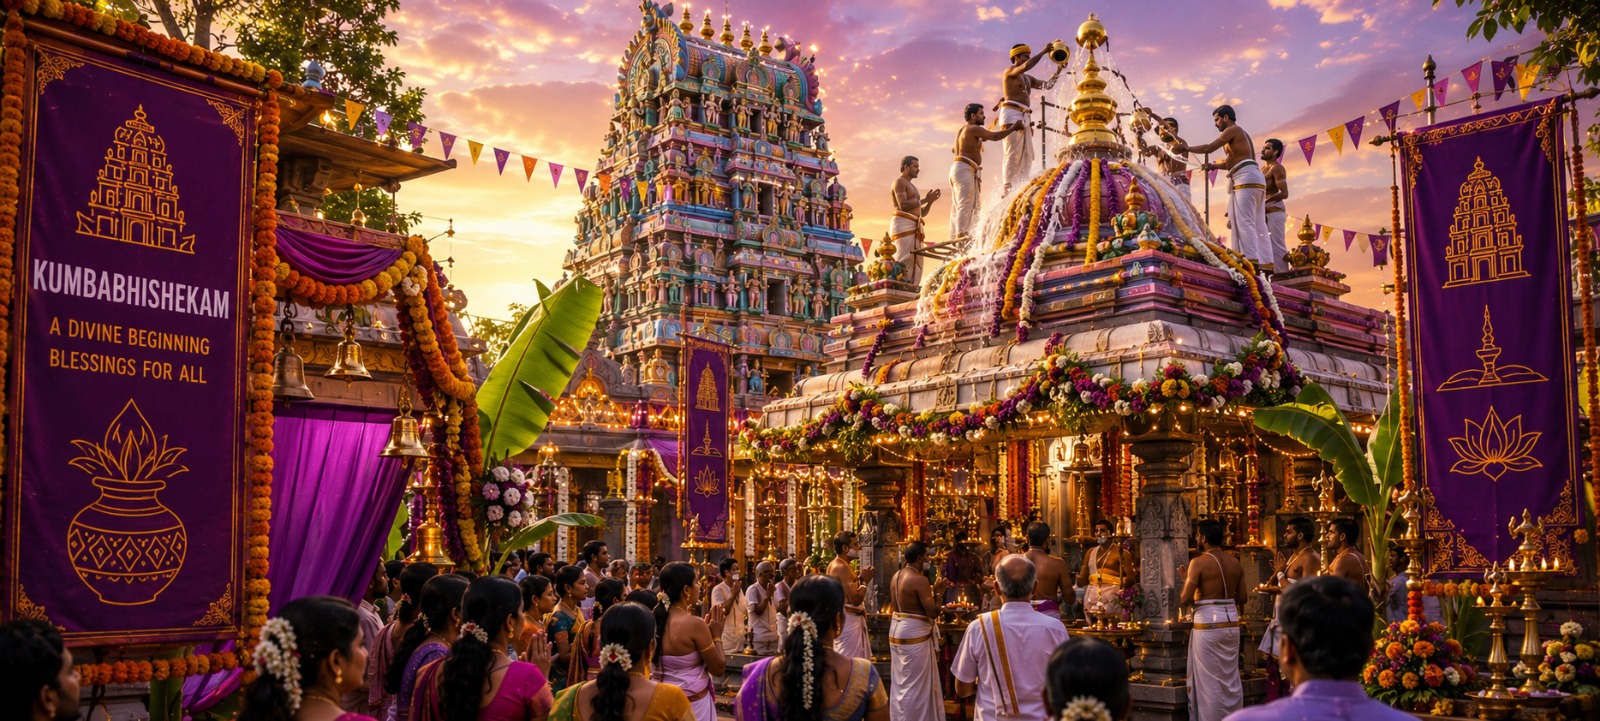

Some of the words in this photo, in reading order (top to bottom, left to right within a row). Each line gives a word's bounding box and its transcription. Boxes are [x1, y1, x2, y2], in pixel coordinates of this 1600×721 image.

[33, 258, 230, 319] KUMBABHISHEKAM
[50, 316, 61, 336] A
[68, 319, 122, 344] DIVINE
[128, 328, 210, 355] BEGINNING
[50, 348, 136, 376] BLESSINGS
[143, 360, 172, 380] FOR
[179, 365, 207, 384] ALL
